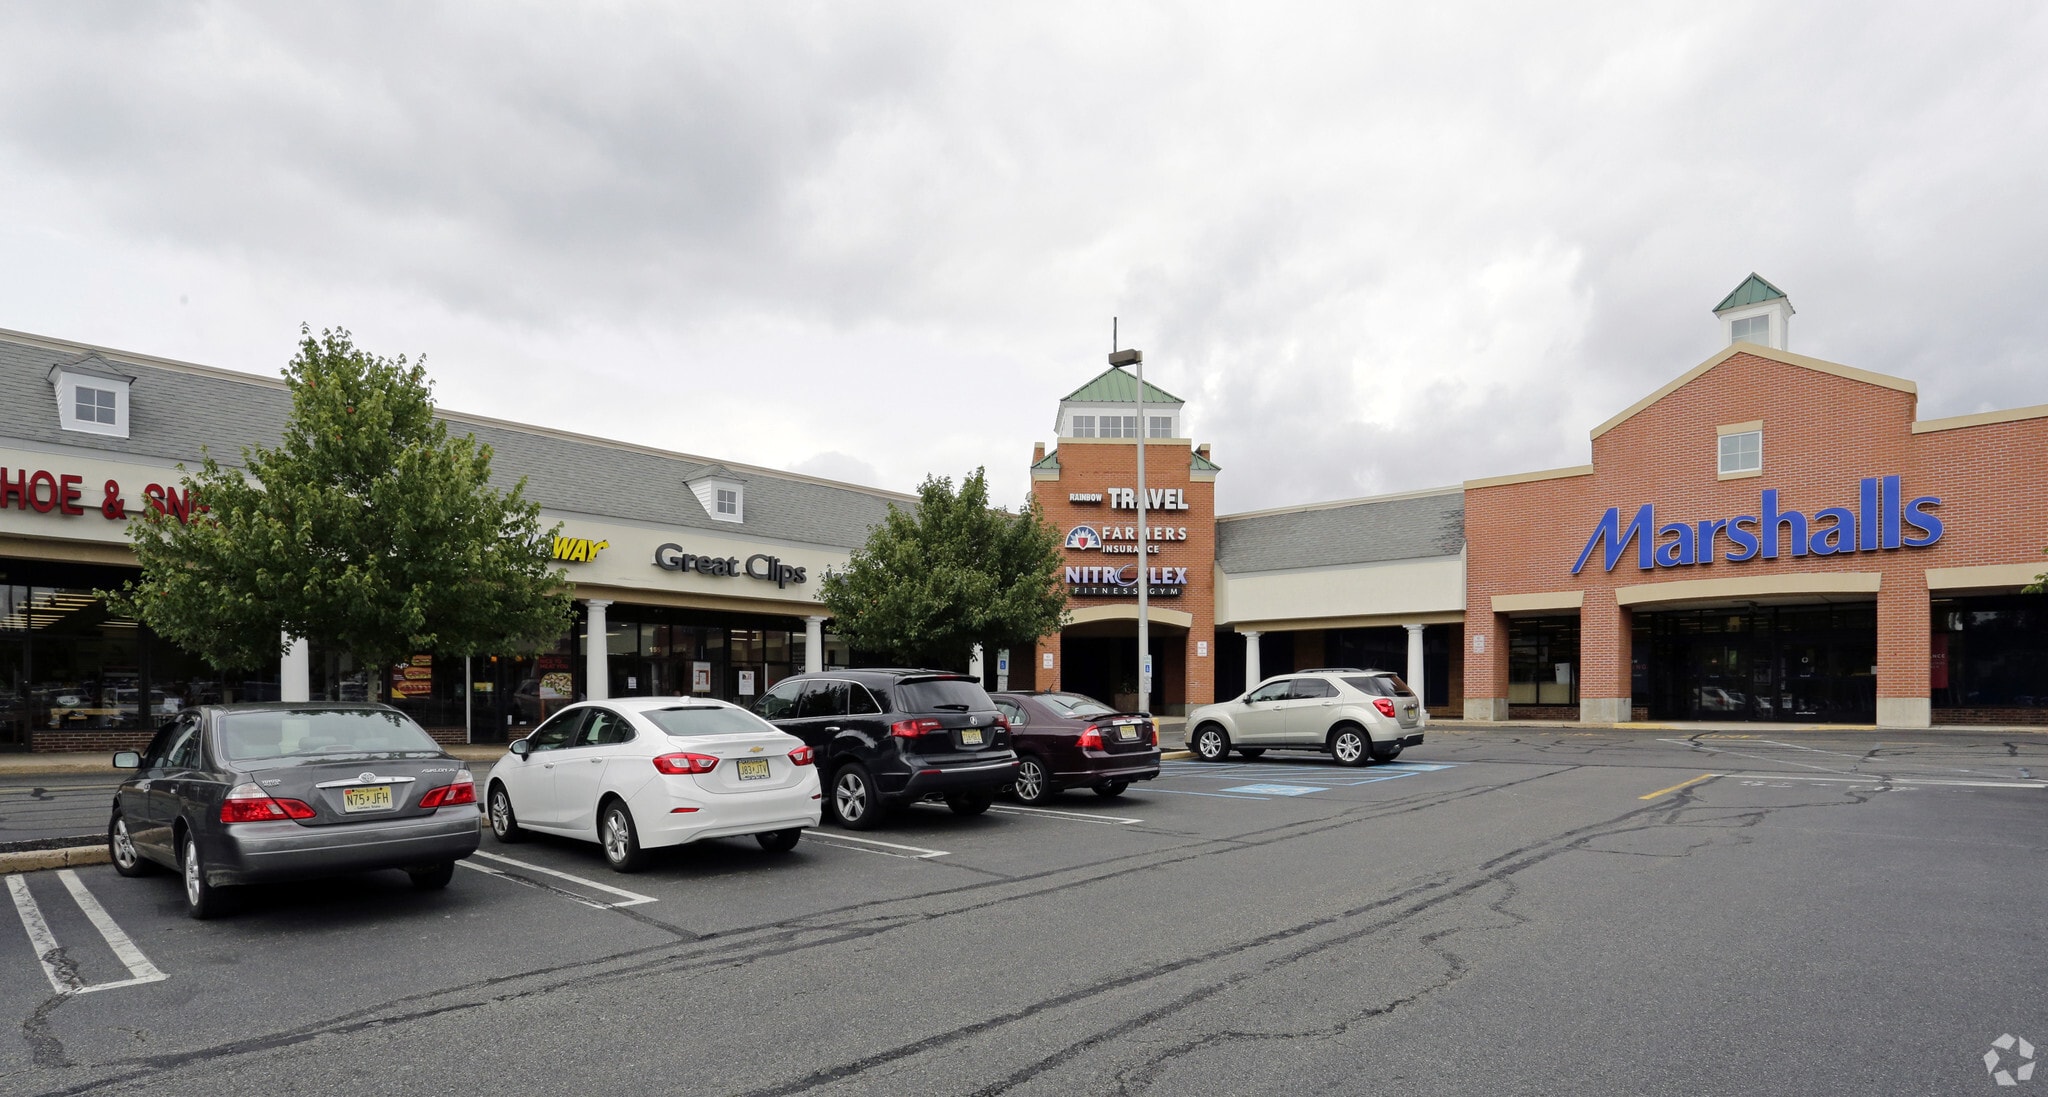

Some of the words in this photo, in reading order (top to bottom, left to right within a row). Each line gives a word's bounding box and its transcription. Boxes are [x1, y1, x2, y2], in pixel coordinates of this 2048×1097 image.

[102, 479, 127, 520] &
[1069, 493, 1102, 502] RAINBOW
[1571, 475, 1944, 574] Marshalls
[1102, 544, 1160, 554] INSURACE
[654, 542, 740, 578] Great
[746, 553, 807, 589] Clips
[1065, 564, 1188, 587] NITROLEX
[1075, 587, 1138, 595] FITNESS
[1149, 587, 1178, 595] GYM
[346, 793, 366, 806] N75
[371, 791, 389, 804] JFH
